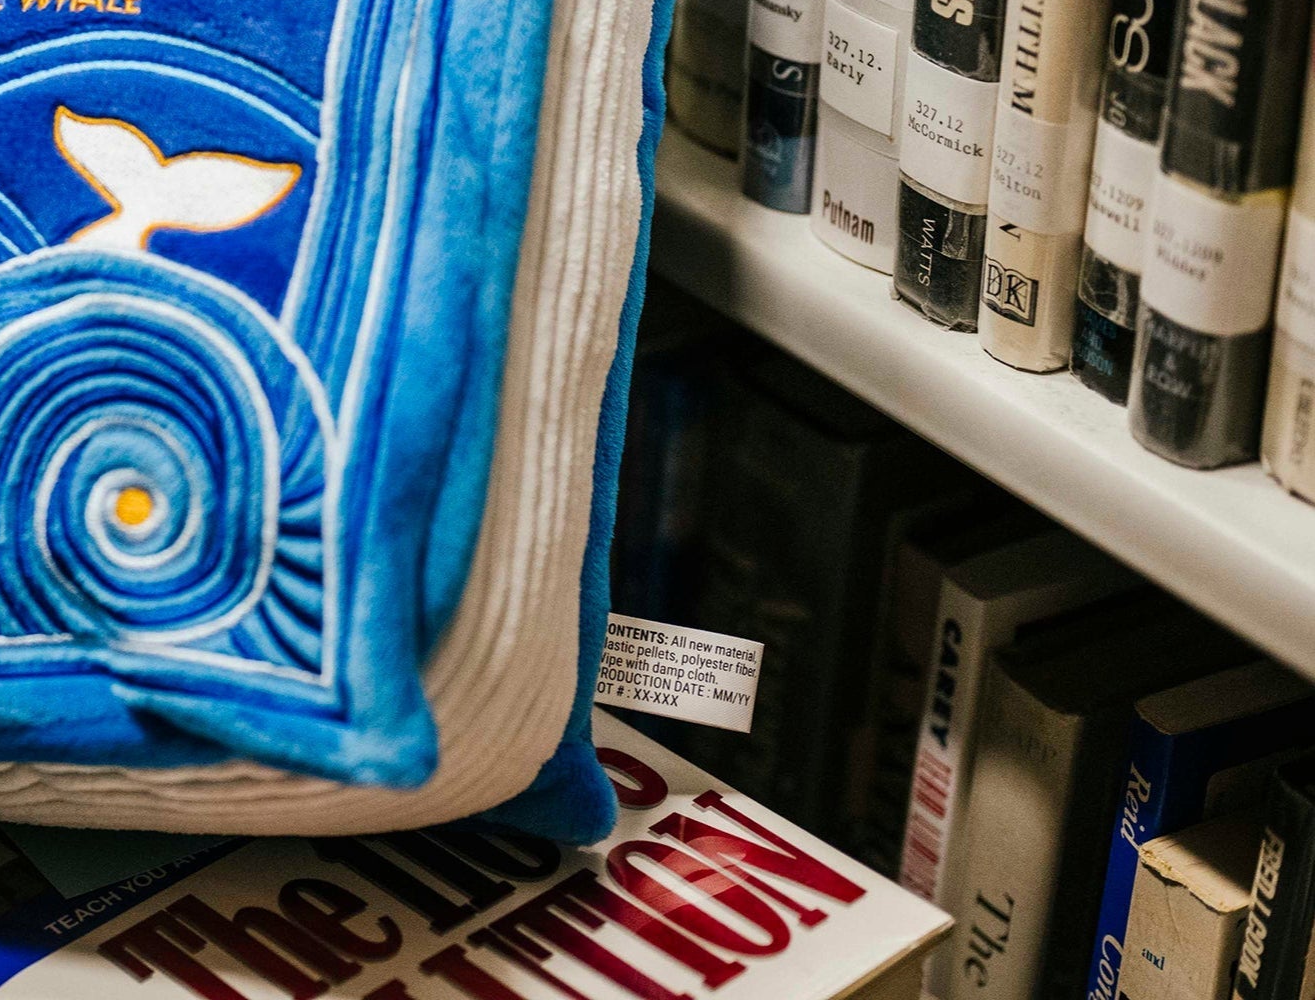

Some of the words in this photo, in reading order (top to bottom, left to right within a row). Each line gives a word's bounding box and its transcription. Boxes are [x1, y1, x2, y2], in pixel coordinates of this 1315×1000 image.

[825, 51, 865, 86] Early
[907, 113, 985, 158] McCormick
[915, 99, 965, 134] 327.12
[822, 189, 875, 246] Putnam
[917, 216, 937, 287] WATTS
[985, 262, 1028, 314] DK
[603, 638, 635, 654] lastic
[637, 645, 679, 664] pellets,
[681, 653, 733, 674] polyester
[735, 662, 757, 679] fiber.
[607, 623, 669, 645] ONTENTS:
[671, 636, 687, 649] All
[688, 641, 712, 653] new
[715, 645, 757, 664] material,
[625, 656, 649, 673] with
[652, 662, 684, 679] damp
[687, 669, 718, 685] cloth.
[934, 616, 963, 749] CAREY
[596, 681, 613, 695] OT
[633, 687, 679, 708] XX-XXX
[674, 680, 704, 697] DATE
[712, 689, 751, 707] MM/YY
[1119, 760, 1153, 851] Reid
[43, 891, 122, 936] TEACH
[118, 867, 168, 895] YOU
[95, 876, 404, 1000] The
[962, 890, 1017, 990] The
[1140, 947, 1166, 971] and
